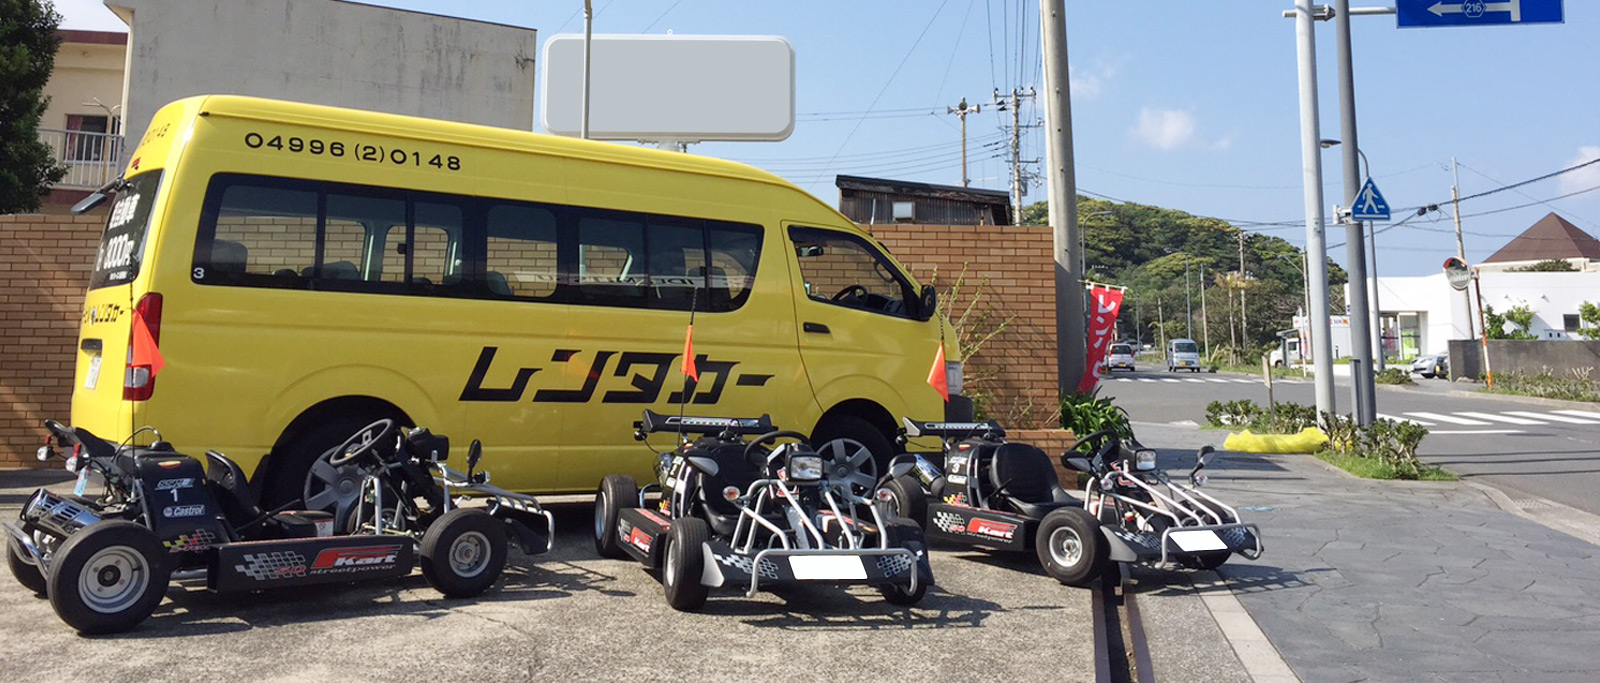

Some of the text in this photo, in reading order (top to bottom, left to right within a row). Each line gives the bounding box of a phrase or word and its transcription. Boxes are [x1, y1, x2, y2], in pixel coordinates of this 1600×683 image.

[1466, 2, 1481, 13] 216
[244, 132, 461, 170] 04996 (2)0148
[193, 267, 205, 279] 3
[457, 346, 775, 405] レンタカー
[951, 463, 960, 473] 3
[170, 488, 178, 502] 1
[173, 506, 204, 517] Castrol
[309, 564, 397, 575] streetpower
